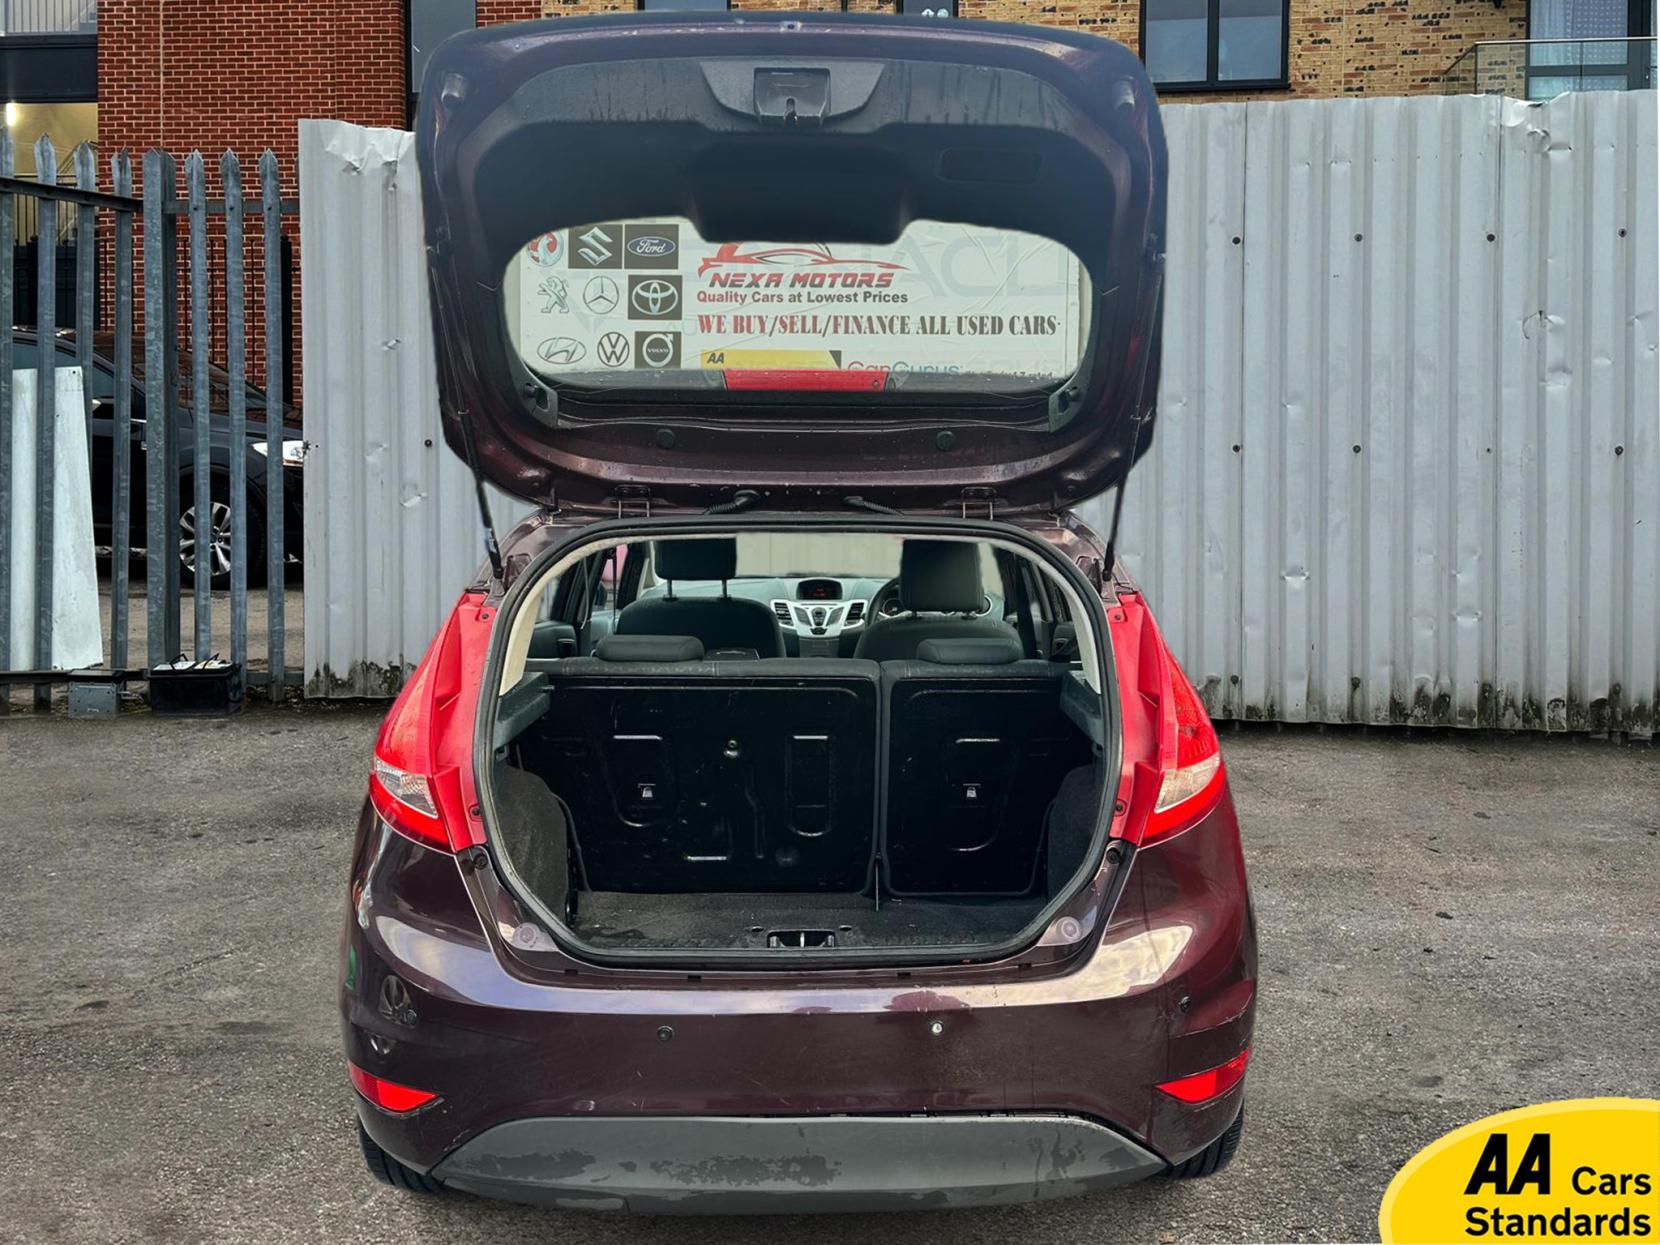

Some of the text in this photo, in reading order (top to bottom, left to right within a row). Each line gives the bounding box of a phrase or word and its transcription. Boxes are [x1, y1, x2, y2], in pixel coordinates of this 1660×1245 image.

[636, 239, 667, 253] Ford
[709, 272, 894, 288] NEXA MOTORS
[697, 290, 908, 305] Quality Cars at Lowest Prices
[697, 314, 727, 334] WE
[916, 315, 950, 335] ALL
[957, 315, 1003, 335] USED
[706, 352, 725, 364] AA
